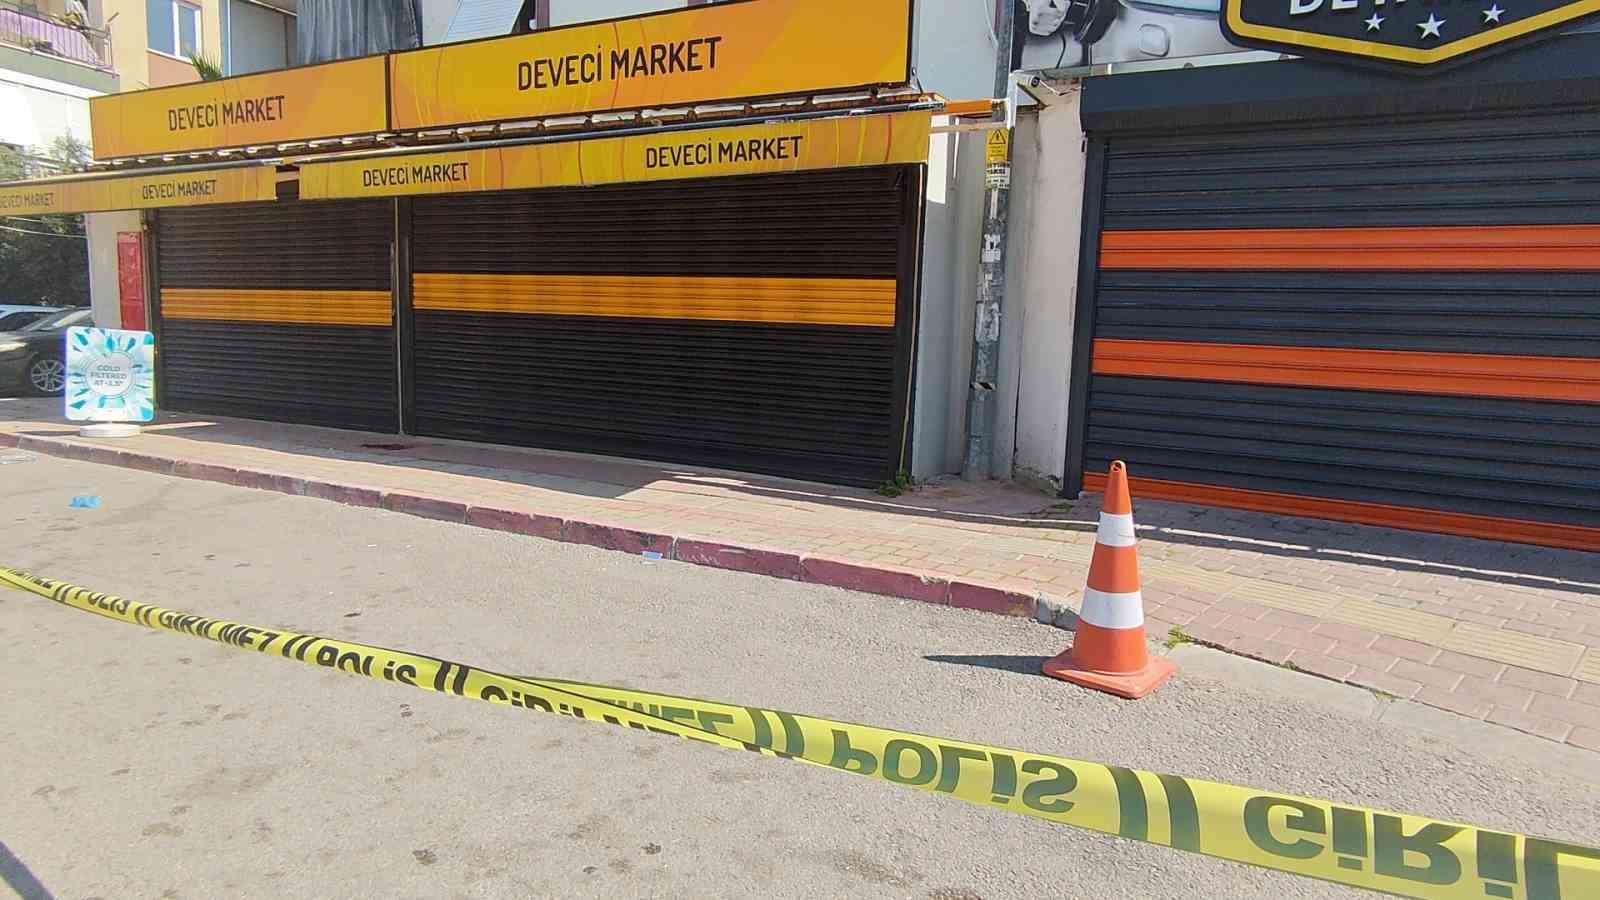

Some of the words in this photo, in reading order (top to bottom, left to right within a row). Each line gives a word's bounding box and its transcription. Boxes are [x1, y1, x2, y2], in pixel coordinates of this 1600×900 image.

[518, 44, 601, 91] DEVECİ
[610, 36, 722, 80] MARKET
[168, 98, 218, 131] DEVECİ
[222, 95, 285, 125] MARKET
[646, 137, 712, 169] DEVECİ
[718, 135, 803, 163] MARKET
[363, 162, 409, 187] DEVECİ
[412, 162, 469, 184] MARKET
[177, 179, 217, 197] MARKET
[90, 371, 128, 380] FILTERED
[97, 364, 120, 372] COLD
